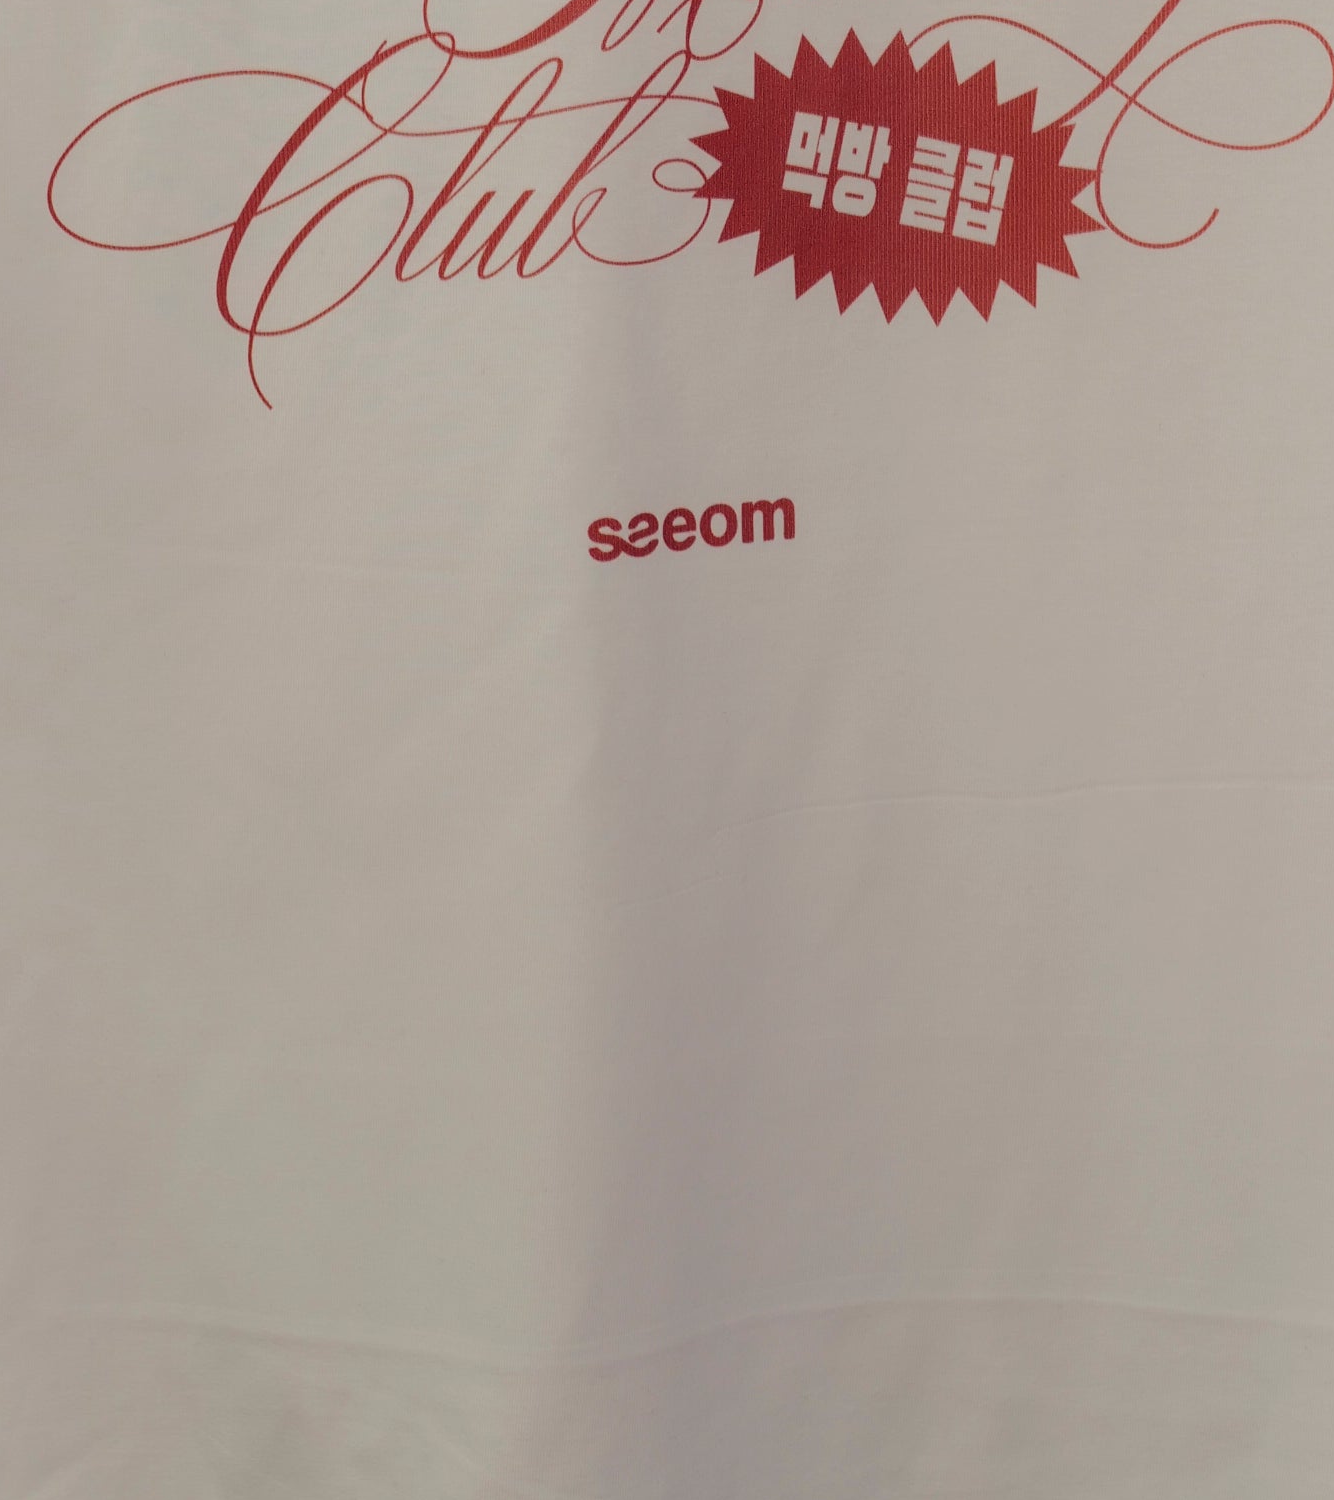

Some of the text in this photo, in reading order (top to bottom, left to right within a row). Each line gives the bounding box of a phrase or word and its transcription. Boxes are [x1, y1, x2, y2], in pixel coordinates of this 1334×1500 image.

[47, 31, 717, 409] Club
[782, 110, 1015, 247] 먹방 클럽
